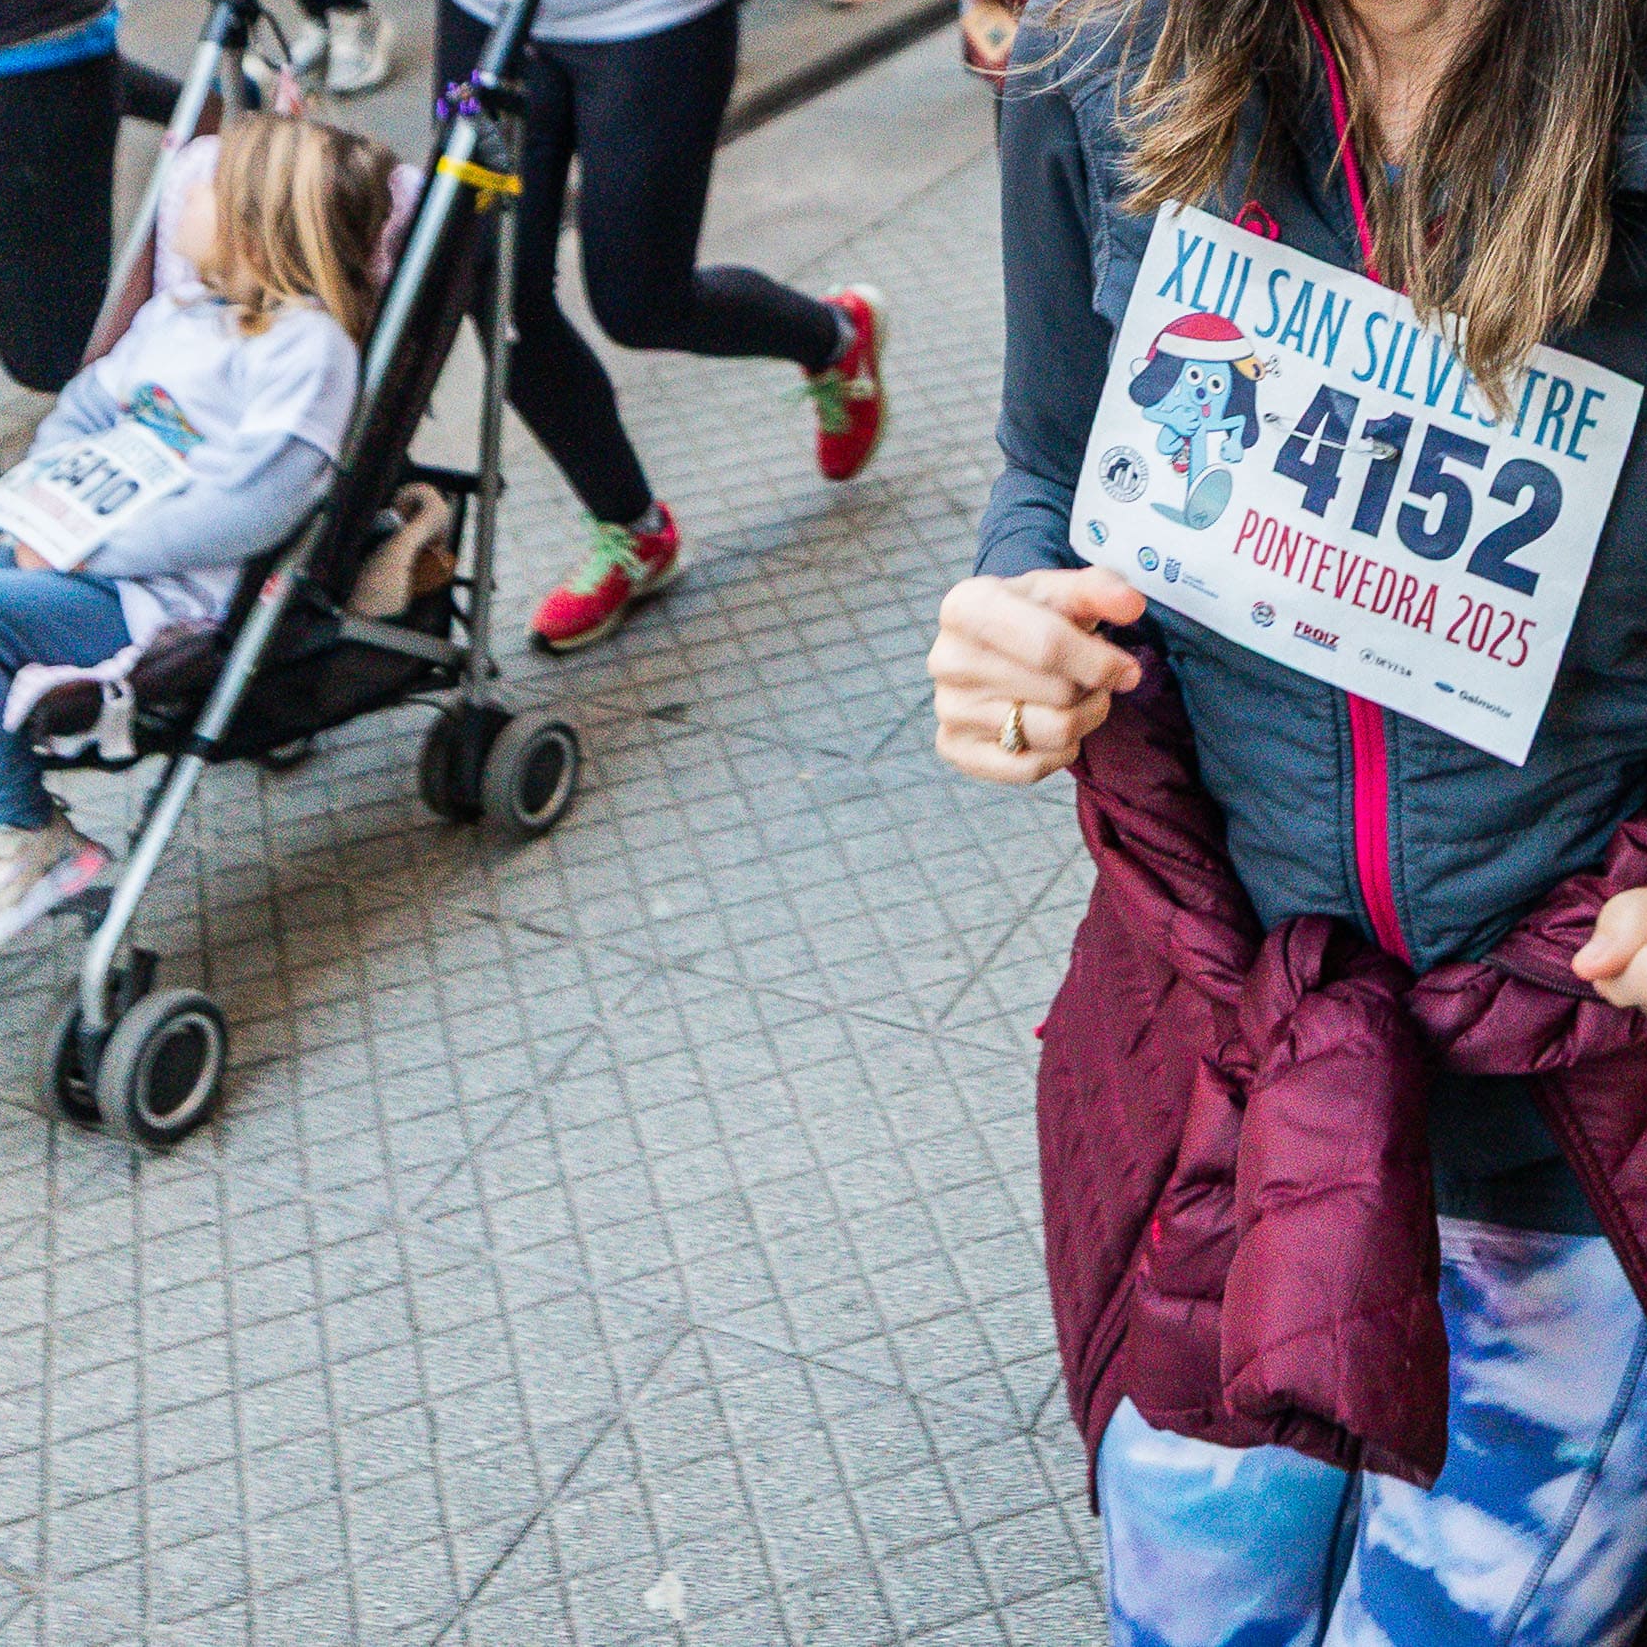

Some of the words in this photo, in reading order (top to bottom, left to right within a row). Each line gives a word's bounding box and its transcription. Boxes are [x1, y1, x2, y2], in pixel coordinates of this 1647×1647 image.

[1157, 229, 1253, 320] XLII
[1255, 268, 1353, 367] SAN
[1352, 311, 1606, 462] SILVETRE
[1272, 384, 1563, 597] 4152
[1233, 509, 1440, 634] PONTEVEDRA
[1445, 594, 1537, 668] 2025
[1295, 620, 1341, 646] FROIZ
